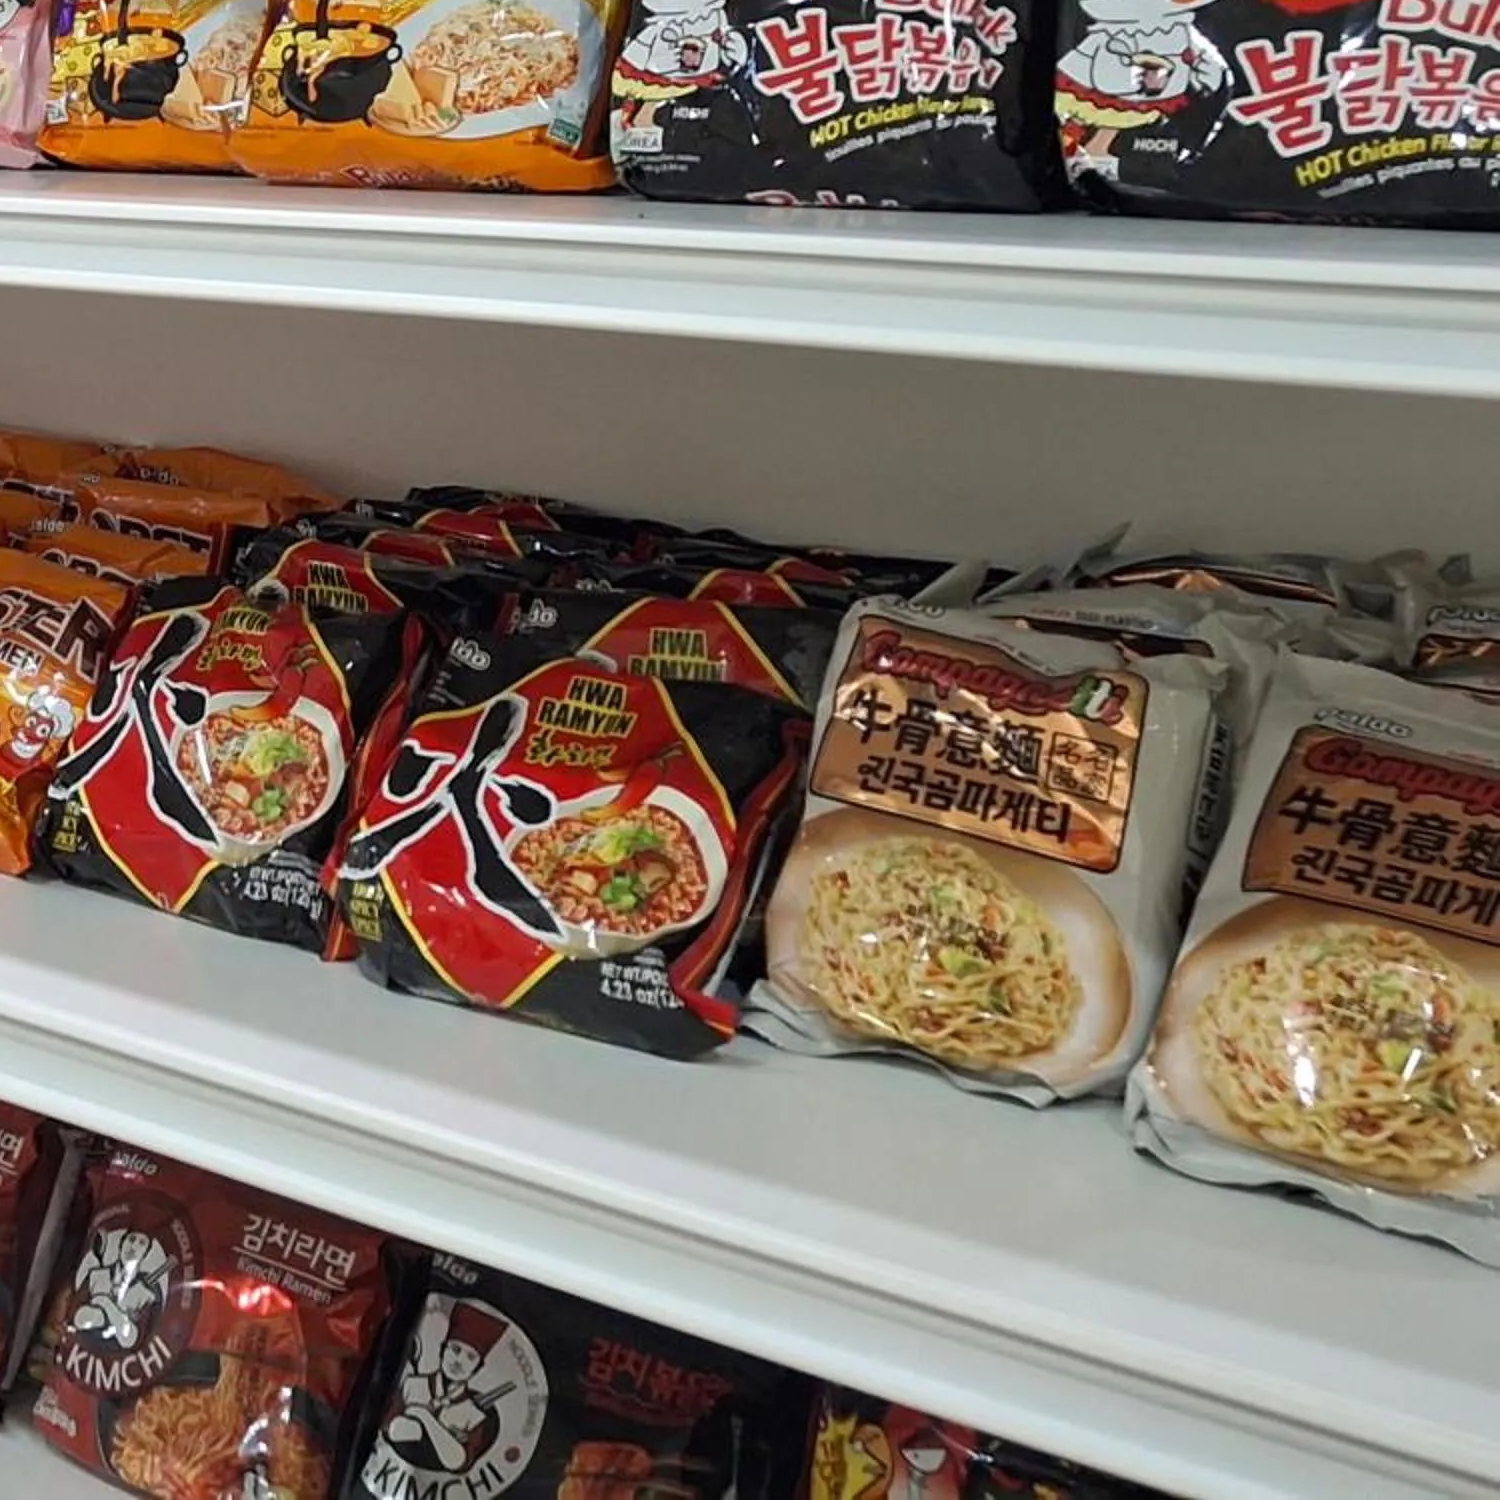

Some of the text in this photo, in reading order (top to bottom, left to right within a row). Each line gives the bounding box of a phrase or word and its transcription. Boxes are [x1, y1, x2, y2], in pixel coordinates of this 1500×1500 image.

[672, 106, 711, 120] HOHI
[809, 119, 851, 149] HOT
[854, 101, 919, 130] Chicken
[1294, 133, 1491, 188] HOT Chicken Flaor
[650, 628, 708, 658] HWA
[536, 697, 638, 739] RAMYUN
[566, 675, 628, 713] HWA
[1290, 843, 1500, 928] 진국곰파게
[239, 1212, 357, 1286] 김치라면
[63, 1333, 174, 1394] KIMCHI
